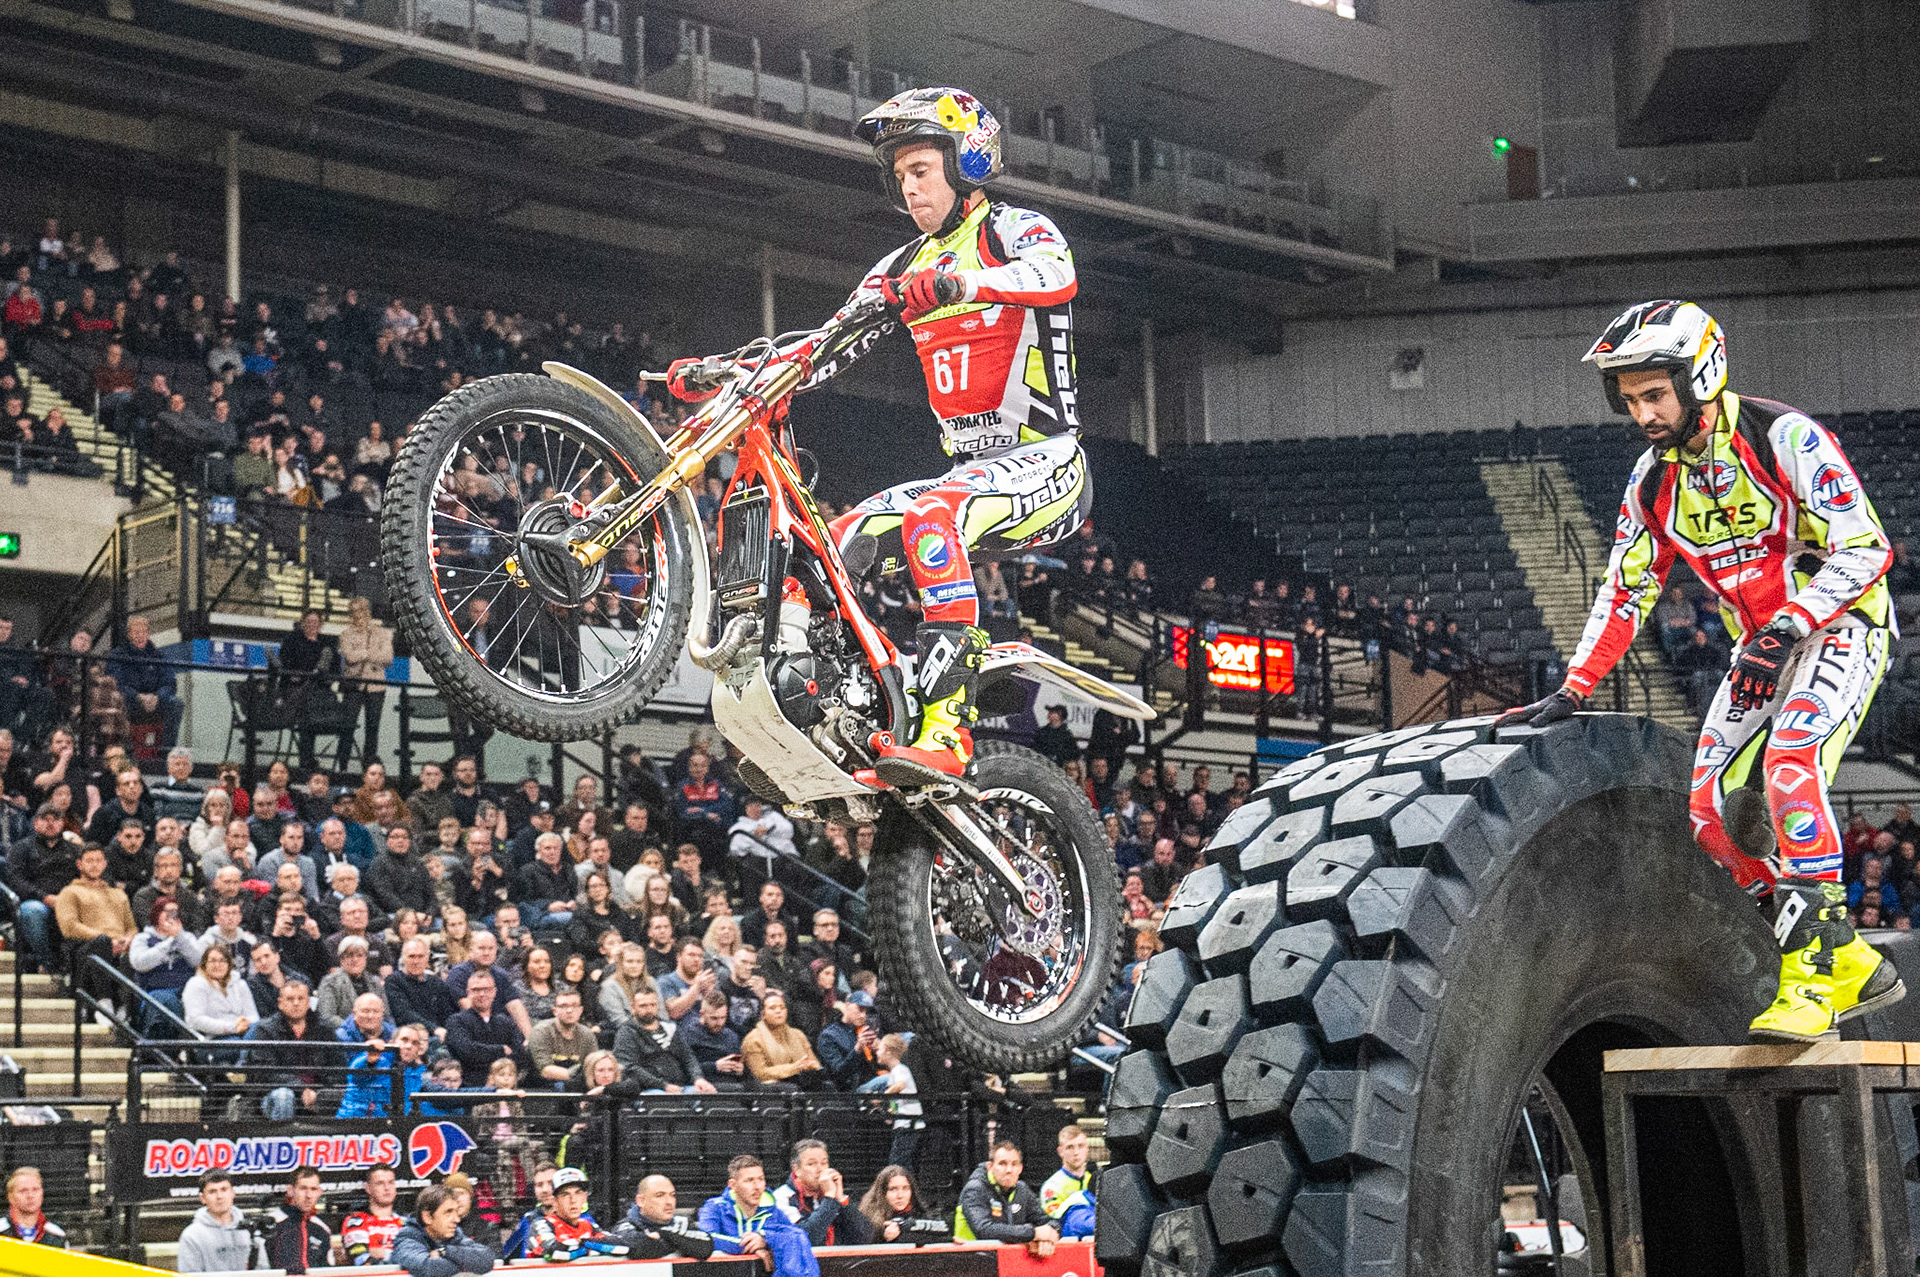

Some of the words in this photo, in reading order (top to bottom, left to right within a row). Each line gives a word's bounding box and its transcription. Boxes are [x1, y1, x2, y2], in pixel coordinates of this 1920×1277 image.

[932, 344, 970, 395] 67
[1009, 461, 1081, 523] hebo
[1811, 473, 1858, 511] NILS
[146, 1137, 401, 1175] ROADANDTRIALS
